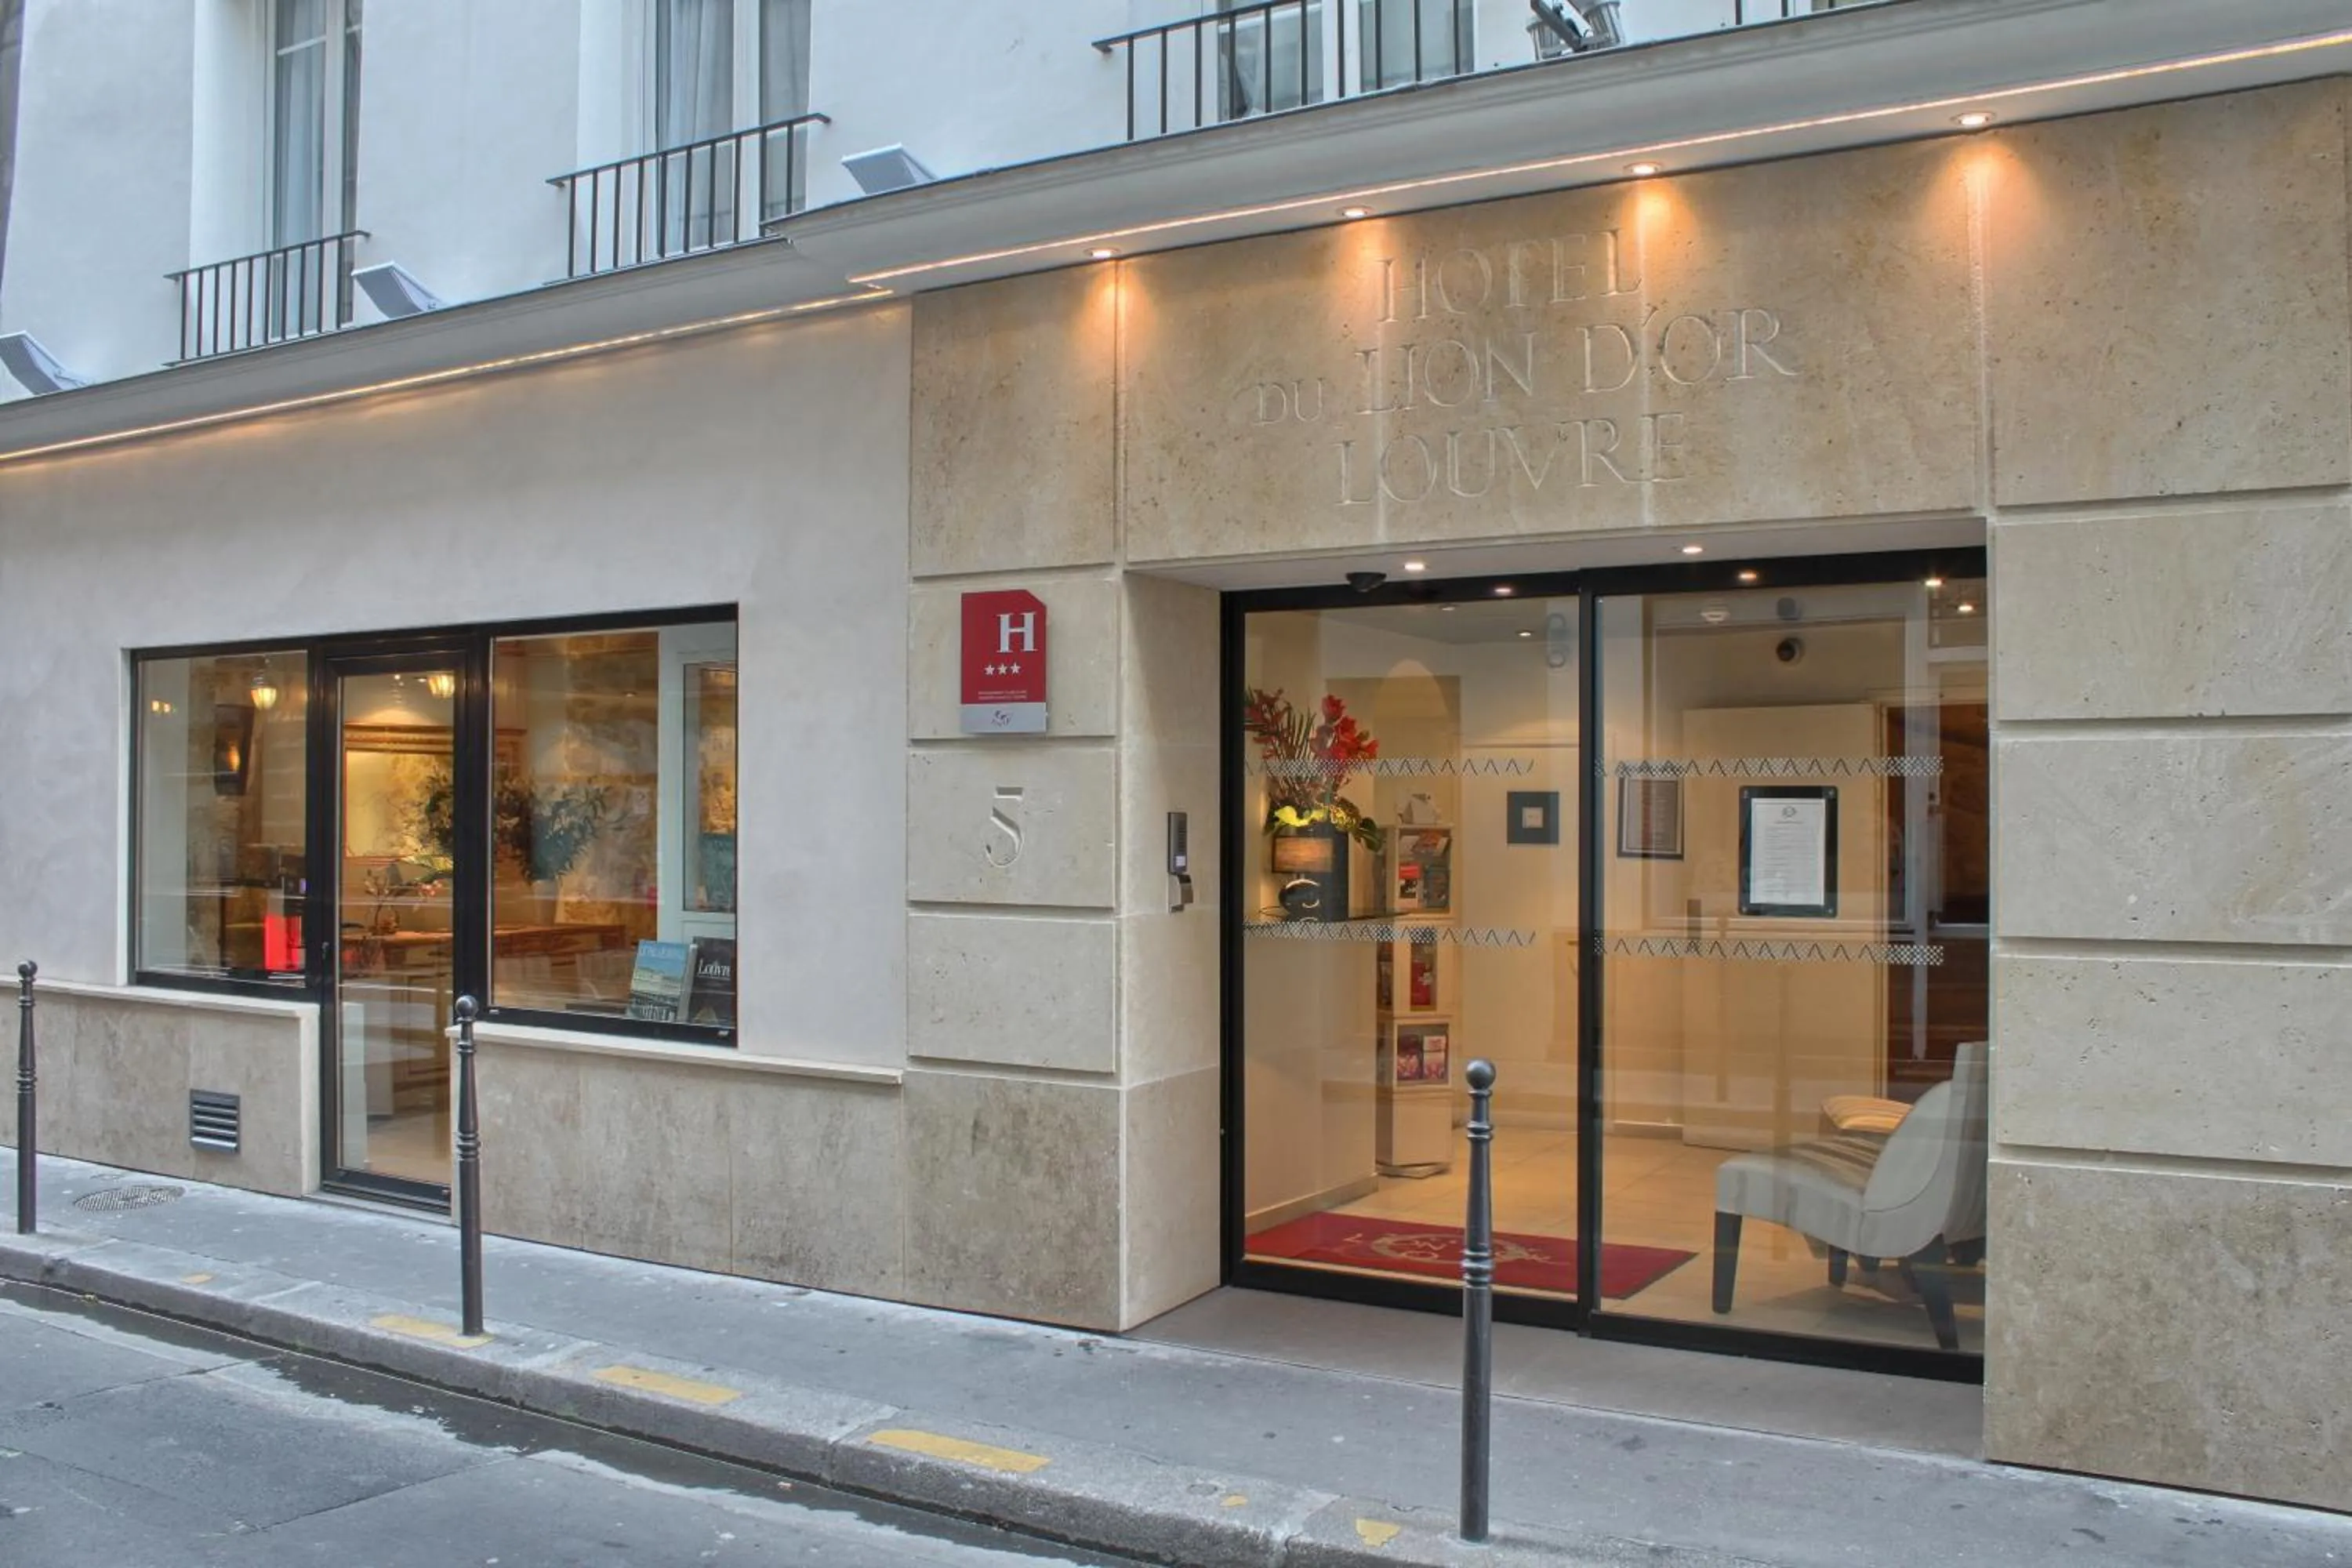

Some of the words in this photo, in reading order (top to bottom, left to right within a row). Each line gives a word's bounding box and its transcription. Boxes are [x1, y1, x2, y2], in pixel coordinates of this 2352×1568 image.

[1374, 227, 1643, 323] HOTEL
[1254, 377, 1325, 426] DU
[1353, 332, 1538, 416] LION
[1574, 306, 1802, 393] D'OR
[1334, 412, 1692, 506] LOUVRE
[996, 612, 1039, 653] H
[985, 786, 1025, 868] 5
